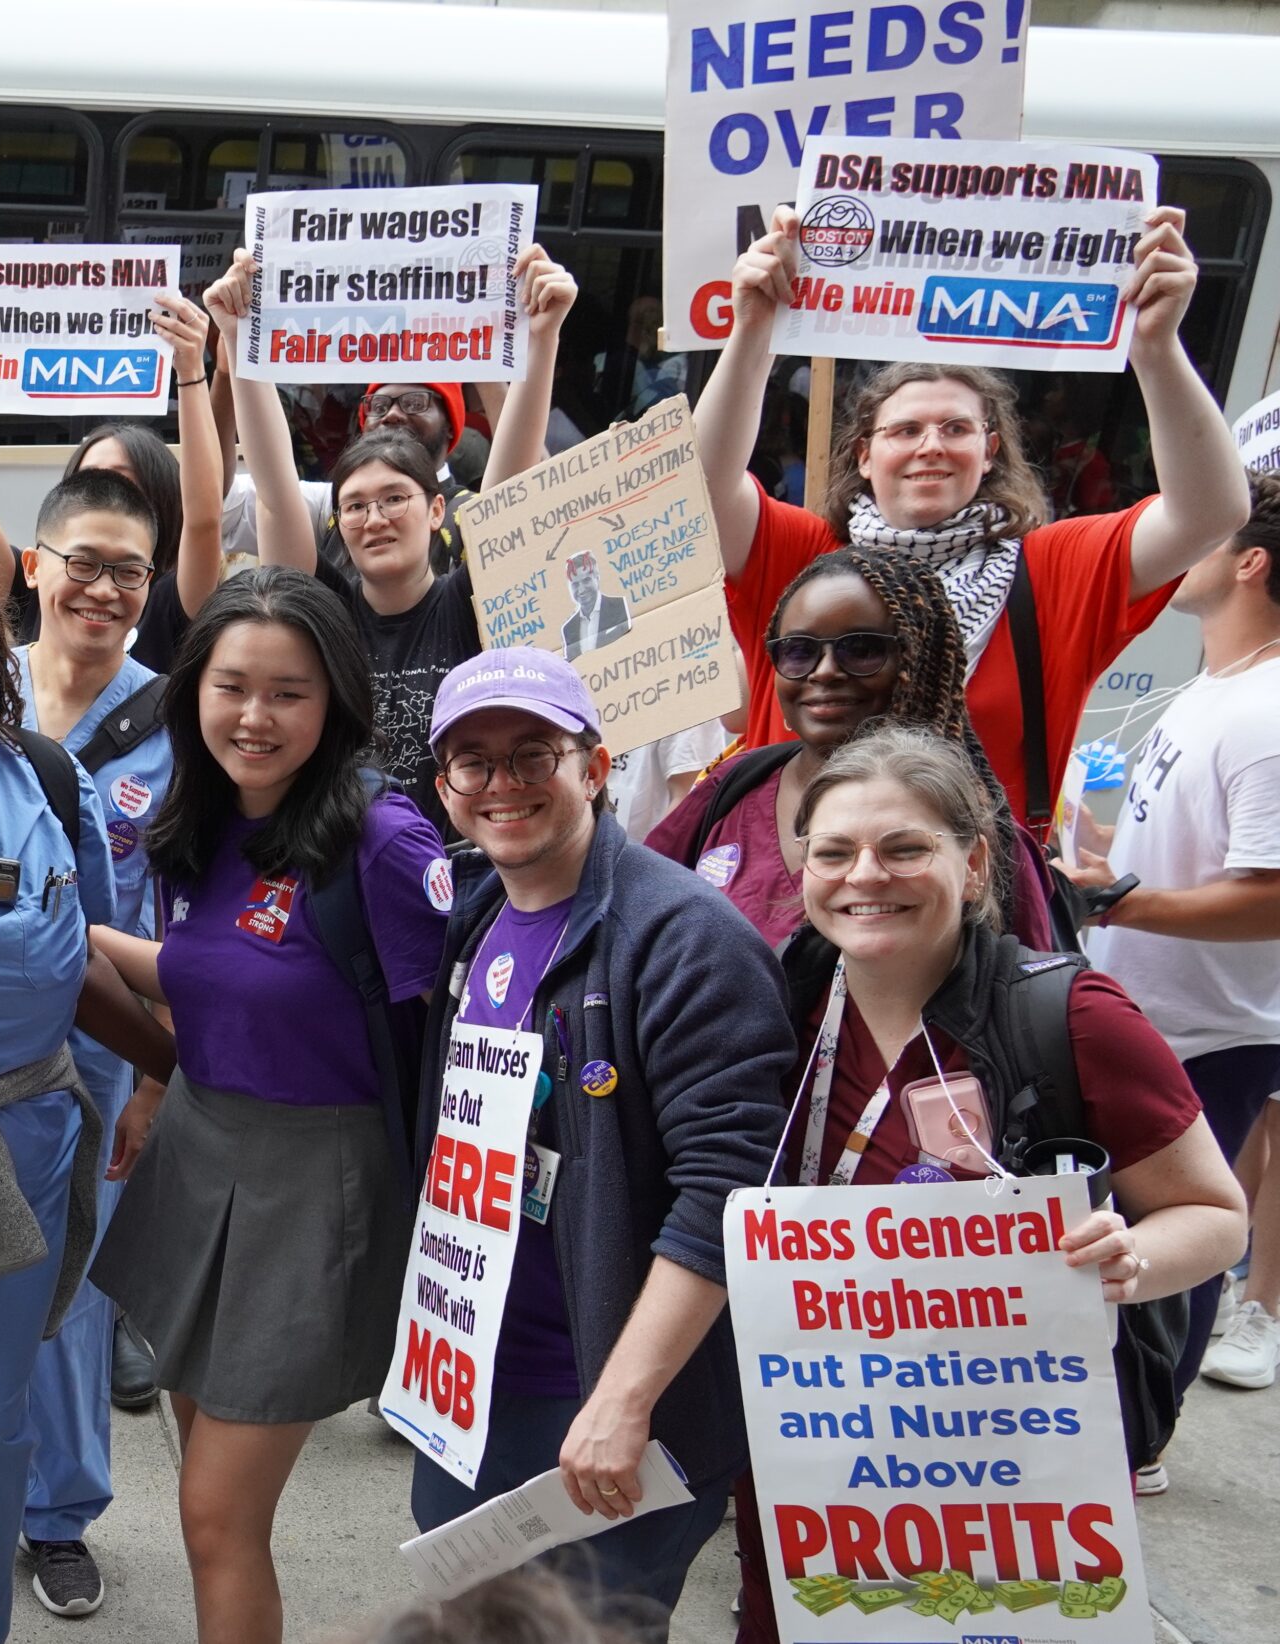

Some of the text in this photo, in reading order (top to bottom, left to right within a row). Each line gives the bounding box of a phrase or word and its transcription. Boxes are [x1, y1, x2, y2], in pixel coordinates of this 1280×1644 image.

[690, 0, 1025, 93] NEEDS!
[814, 153, 1144, 202] DSA supports MNA
[256, 206, 266, 241] world
[291, 202, 482, 244] Fair wages!
[508, 201, 523, 254] Workers
[804, 229, 868, 245] BOSTON
[880, 219, 1143, 267] When we fight
[253, 242, 264, 264] the
[813, 246, 843, 258] DSA
[111, 259, 168, 287] MNA
[279, 264, 489, 304] Fair staffing!
[67, 311, 103, 334] we
[110, 308, 170, 338] figh
[504, 309, 517, 329] the
[790, 276, 844, 313] We
[852, 281, 915, 316] win
[928, 286, 1099, 332] MNA
[248, 316, 261, 365] Workers
[270, 325, 494, 363] Fair contract!
[502, 332, 515, 368] world
[29, 356, 146, 385] MNA
[1256, 406, 1280, 436] wag
[467, 407, 684, 526] JAMES TAICLET PROFITS
[478, 441, 695, 570] FROM BOMBING HOSPITALS
[604, 499, 688, 554] DOESN'T
[610, 512, 708, 574] VALUE NURSES
[620, 543, 696, 590] WHO SAVE
[482, 569, 546, 615] DOESN'T
[630, 574, 678, 604] LIVES
[486, 596, 541, 637] VALUE
[581, 614, 722, 693] ONTRACT NOW
[456, 664, 547, 692] union doc
[677, 661, 720, 694] MGB
[1098, 671, 1153, 697] .org
[108, 831, 134, 846] OCTORS
[248, 918, 275, 933] STRONG
[253, 911, 276, 925] UNION
[477, 1037, 530, 1079] Nurses
[582, 1062, 607, 1082] WE ARE
[441, 1085, 483, 1127] Are Out
[743, 1197, 1066, 1262] Mass General
[419, 1220, 486, 1282] Something is
[417, 1273, 476, 1337] WRONG with
[792, 1278, 1028, 1340] Brigham:
[401, 1318, 475, 1433] MGB
[758, 1350, 1089, 1388] Put Patients
[779, 1404, 1081, 1439] and Nurses
[847, 1454, 1022, 1489] Above
[773, 1502, 1124, 1583] PROFITS
